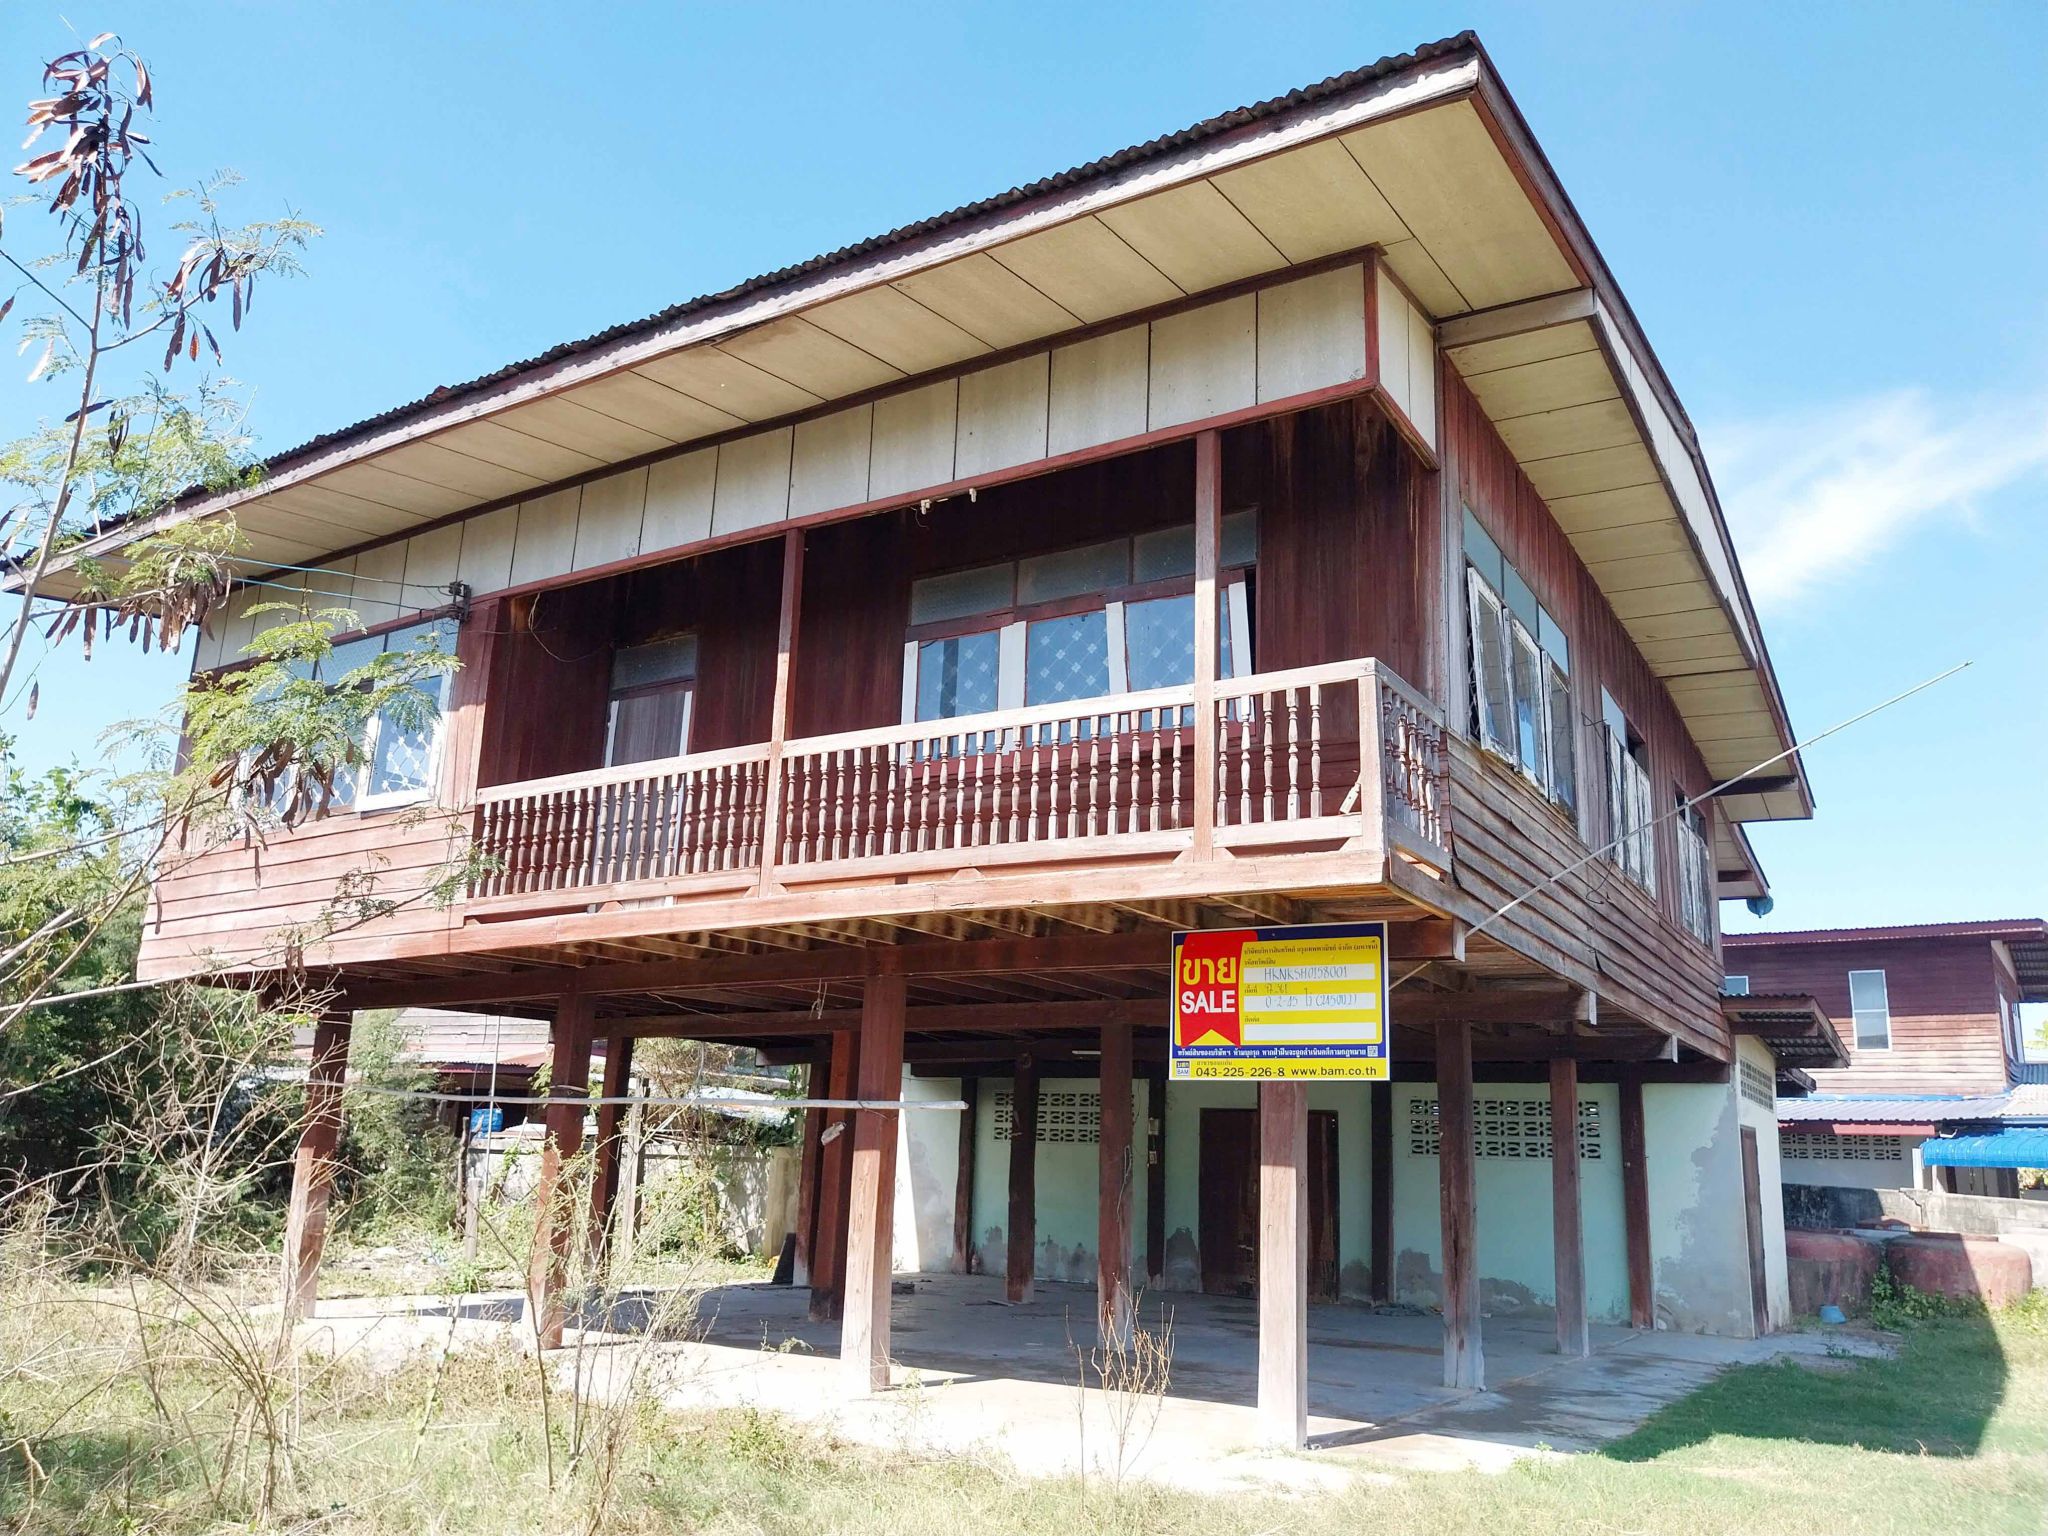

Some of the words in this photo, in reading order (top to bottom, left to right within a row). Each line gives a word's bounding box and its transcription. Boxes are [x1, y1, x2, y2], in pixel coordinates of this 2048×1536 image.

[1183, 957, 1237, 985] ขาย
[1181, 990, 1236, 1014] SALE
[1195, 1067, 1286, 1077] 043-225-226-8
[1291, 1066, 1378, 1076] www.bam.co.th
